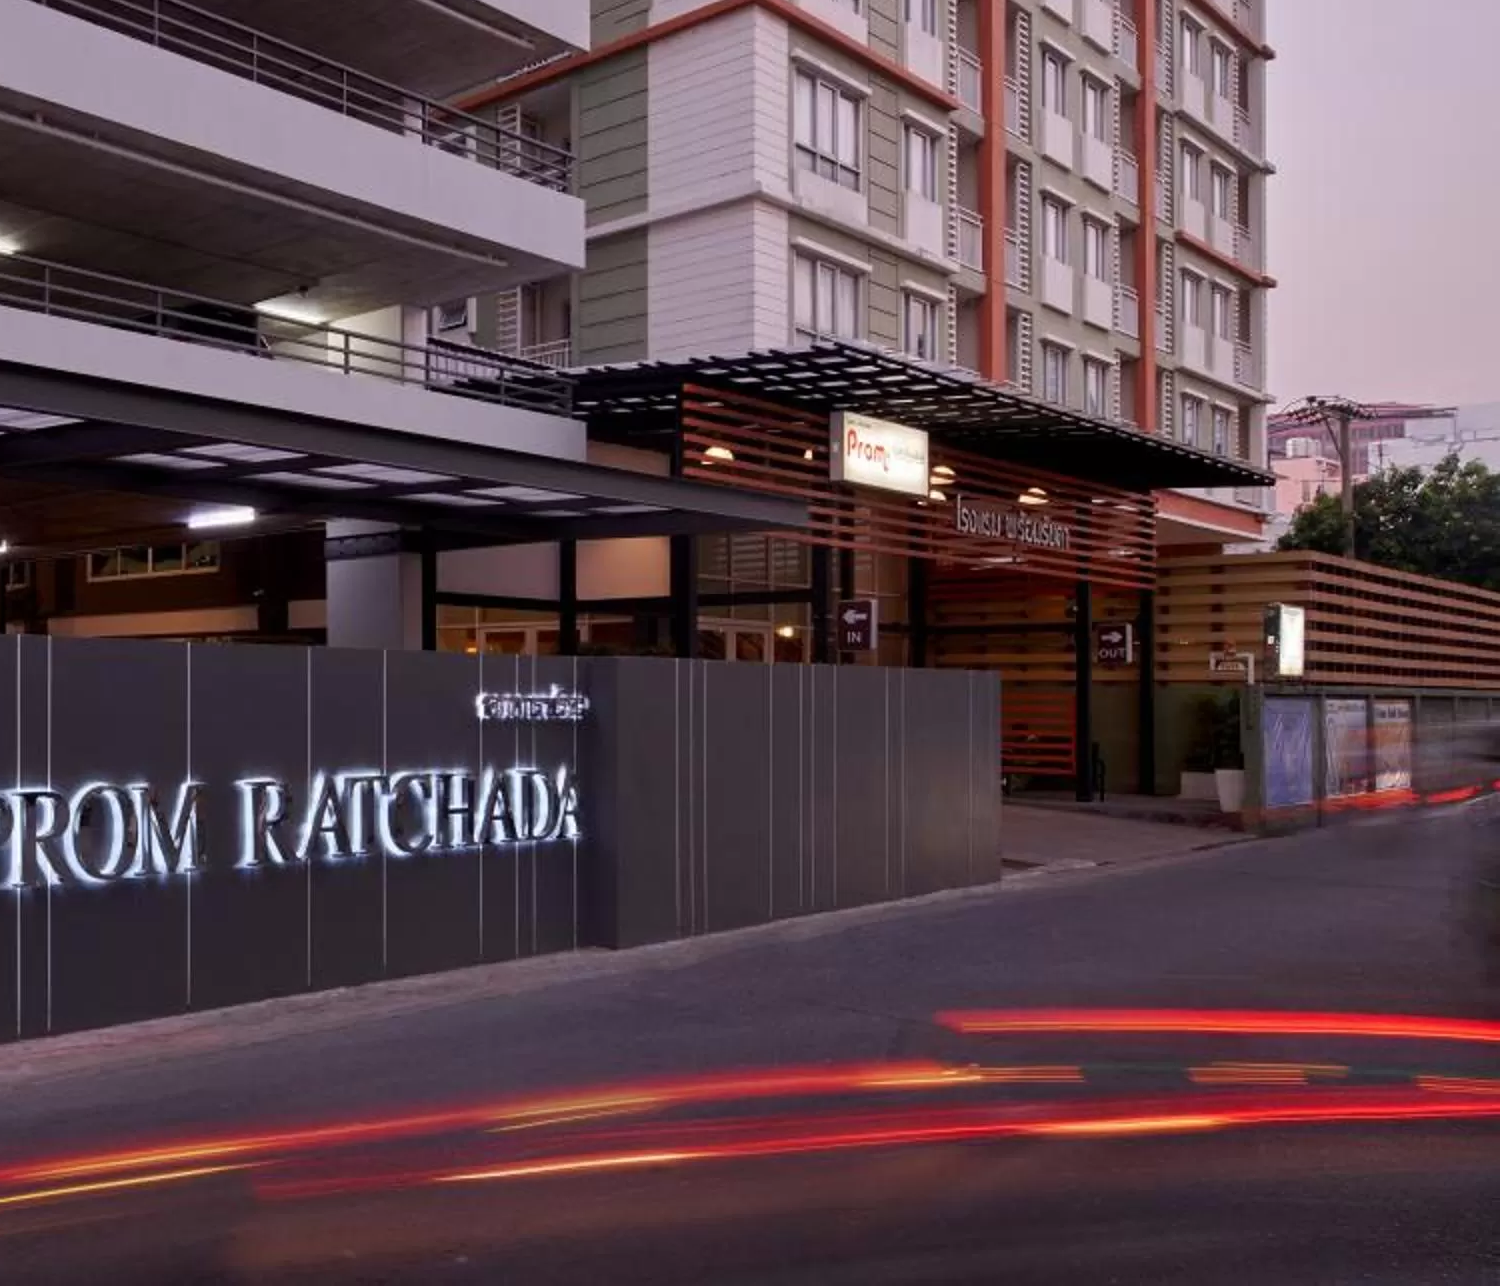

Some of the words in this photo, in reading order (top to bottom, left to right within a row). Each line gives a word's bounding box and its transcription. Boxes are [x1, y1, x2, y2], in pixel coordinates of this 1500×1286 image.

[847, 428, 889, 471] Prom
[847, 631, 862, 643] IN
[1100, 648, 1126, 659] OUT
[237, 762, 583, 870] RATCHADA
